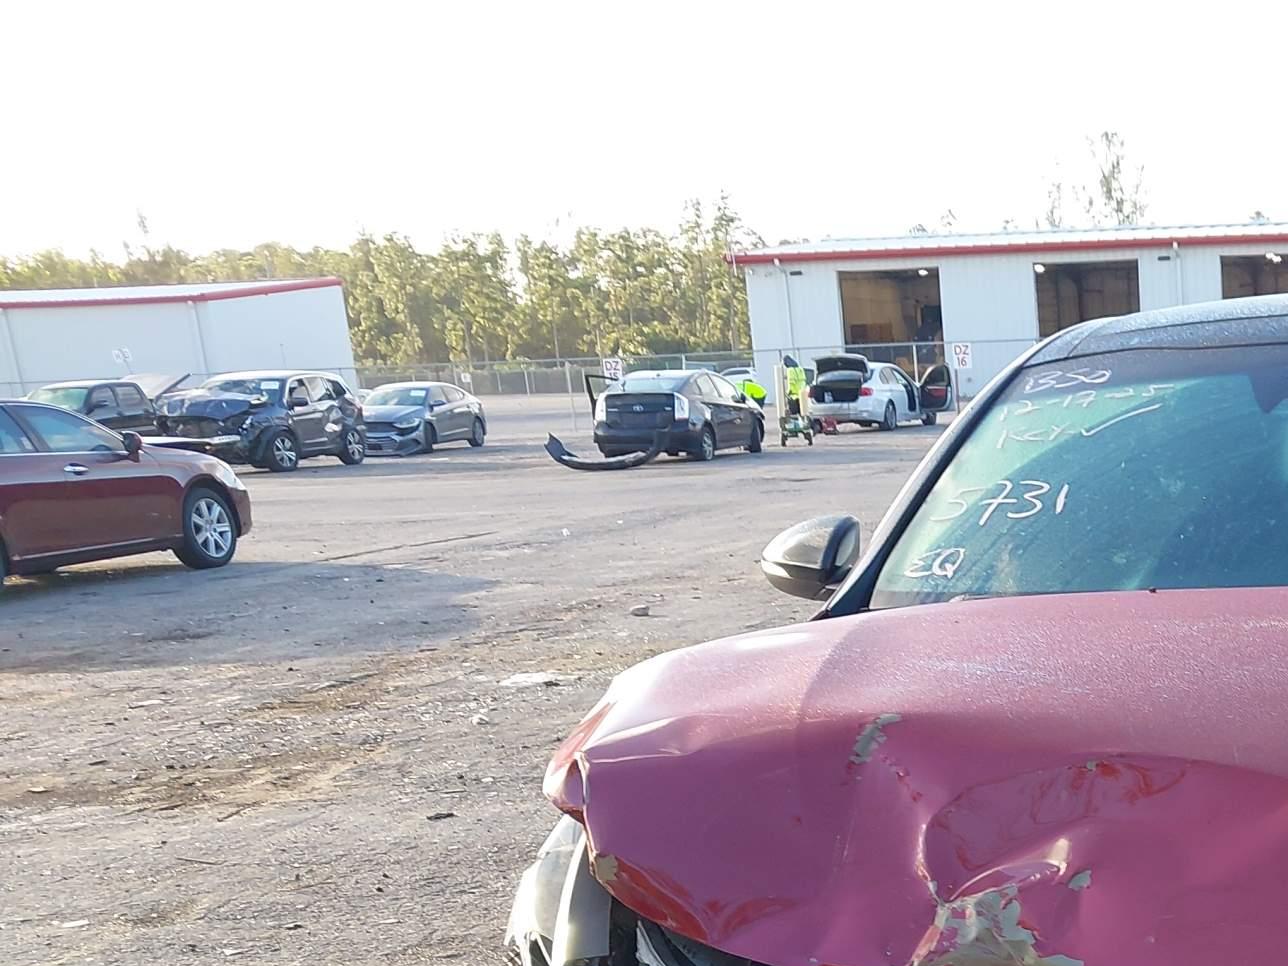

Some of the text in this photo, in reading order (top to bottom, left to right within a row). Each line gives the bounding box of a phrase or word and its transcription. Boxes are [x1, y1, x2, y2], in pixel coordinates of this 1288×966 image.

[954, 344, 969, 356] DZ
[605, 361, 620, 371] DZ
[957, 356, 967, 367] 16
[929, 480, 1069, 526] 5731
